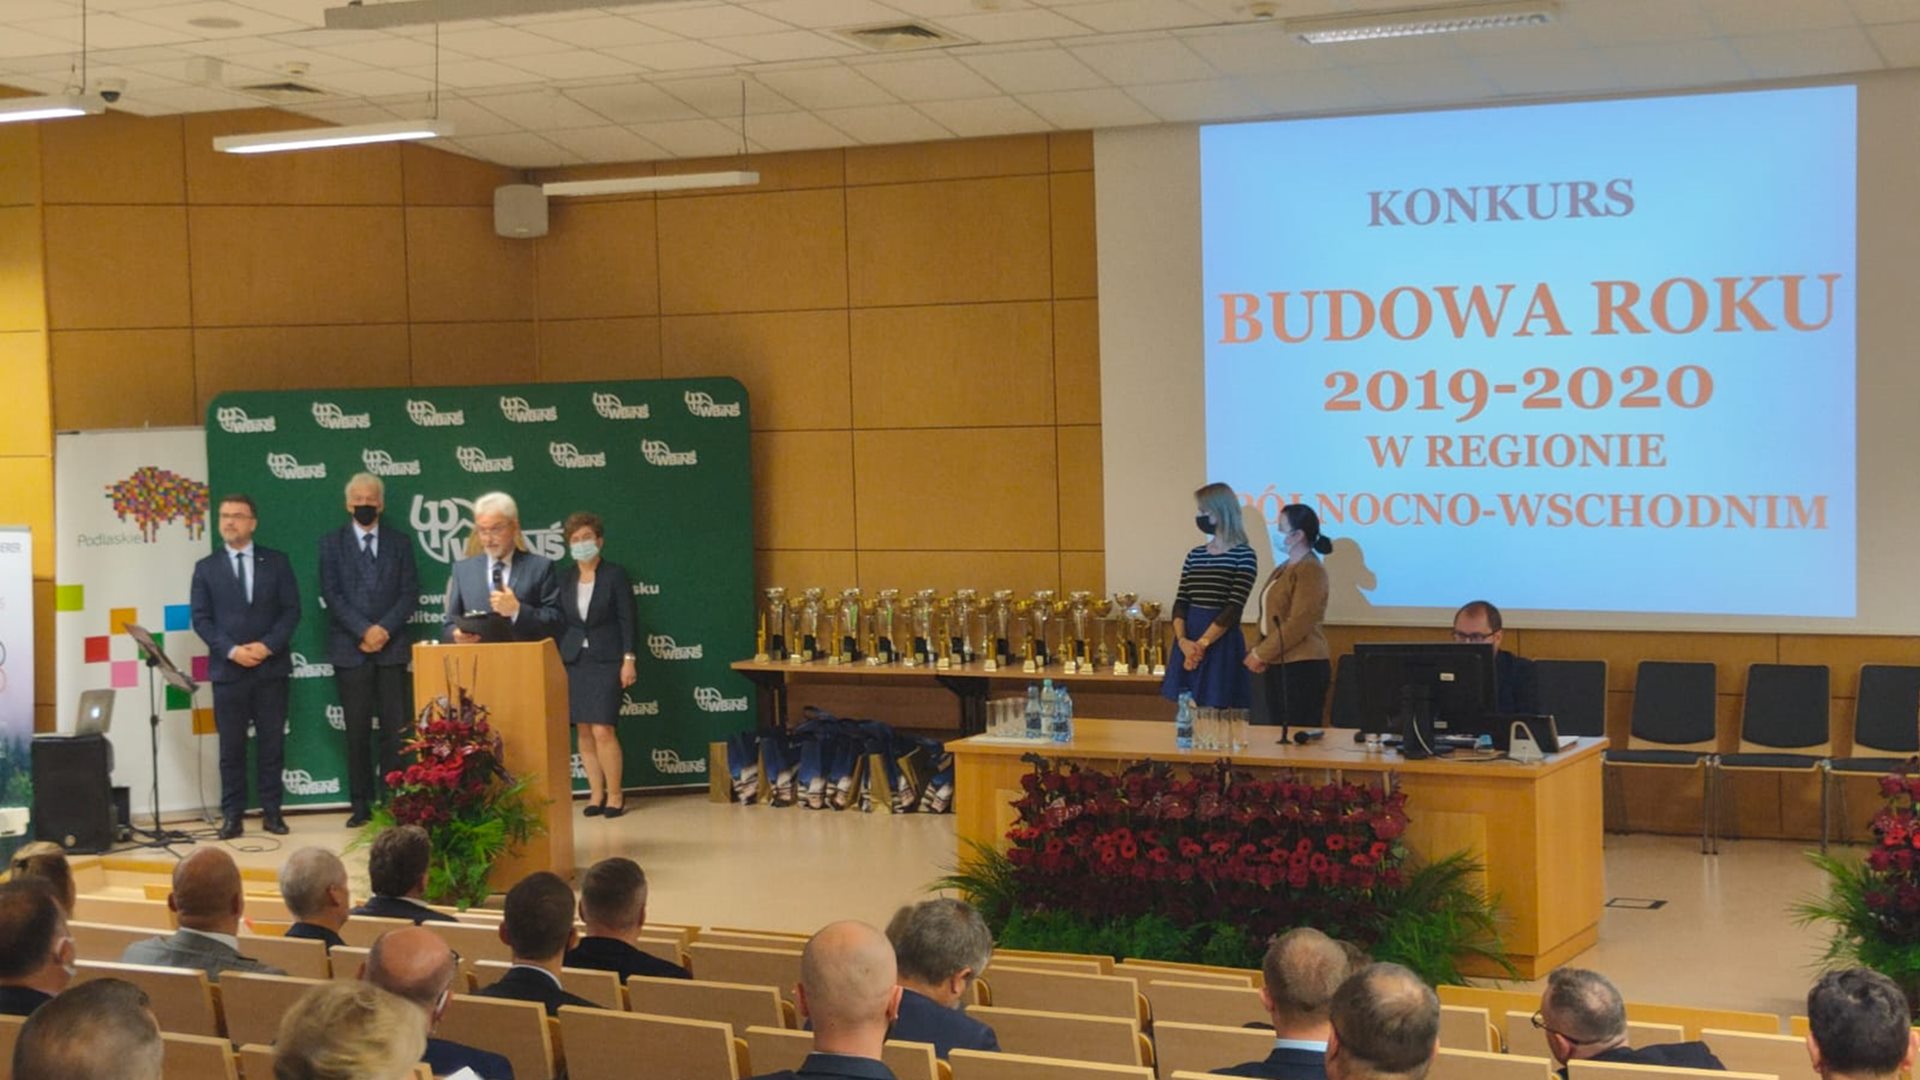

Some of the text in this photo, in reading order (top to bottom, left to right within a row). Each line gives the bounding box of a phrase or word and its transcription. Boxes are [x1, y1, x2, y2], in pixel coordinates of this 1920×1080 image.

[1368, 178, 1635, 228] KONKURS
[1218, 272, 1843, 345] BUDOWA ROKU
[1323, 364, 1715, 424] 2019-2020
[1365, 432, 1668, 469] W REGIONIE
[77, 532, 142, 549] Podlaskie
